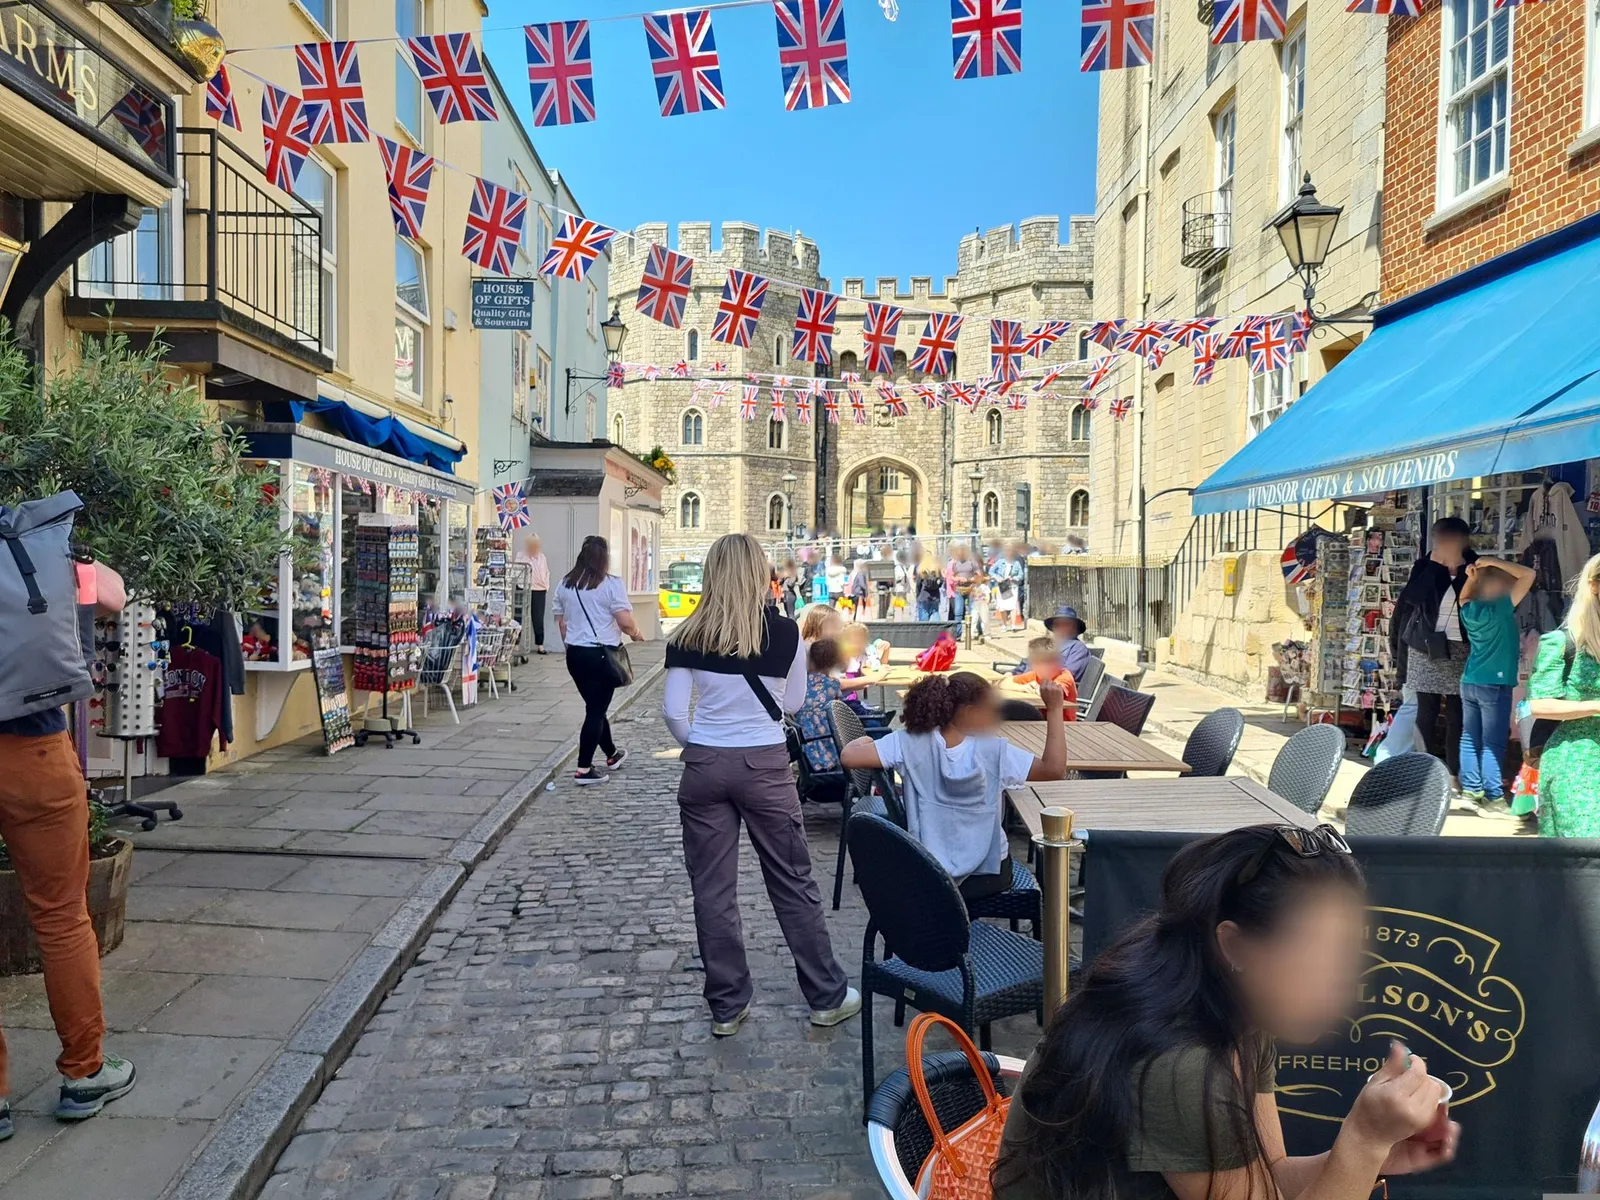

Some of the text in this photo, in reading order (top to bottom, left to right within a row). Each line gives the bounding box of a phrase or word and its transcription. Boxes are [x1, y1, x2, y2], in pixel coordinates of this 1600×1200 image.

[482, 284, 524, 294] HOUSE
[474, 295, 530, 306] OF GIFTS
[473, 308, 531, 319] Quality Gifts
[474, 318, 529, 327] & Souvenirs
[335, 448, 361, 471] HOUSE
[361, 456, 373, 473] OF
[373, 460, 393, 479] GIFTS
[1247, 449, 1459, 508] WINDSOR GIFTS & SOUVENIRS
[1363, 925, 1420, 948] 1873
[1357, 983, 1491, 1043] LSON'S
[1278, 1055, 1428, 1072] FREEHO
